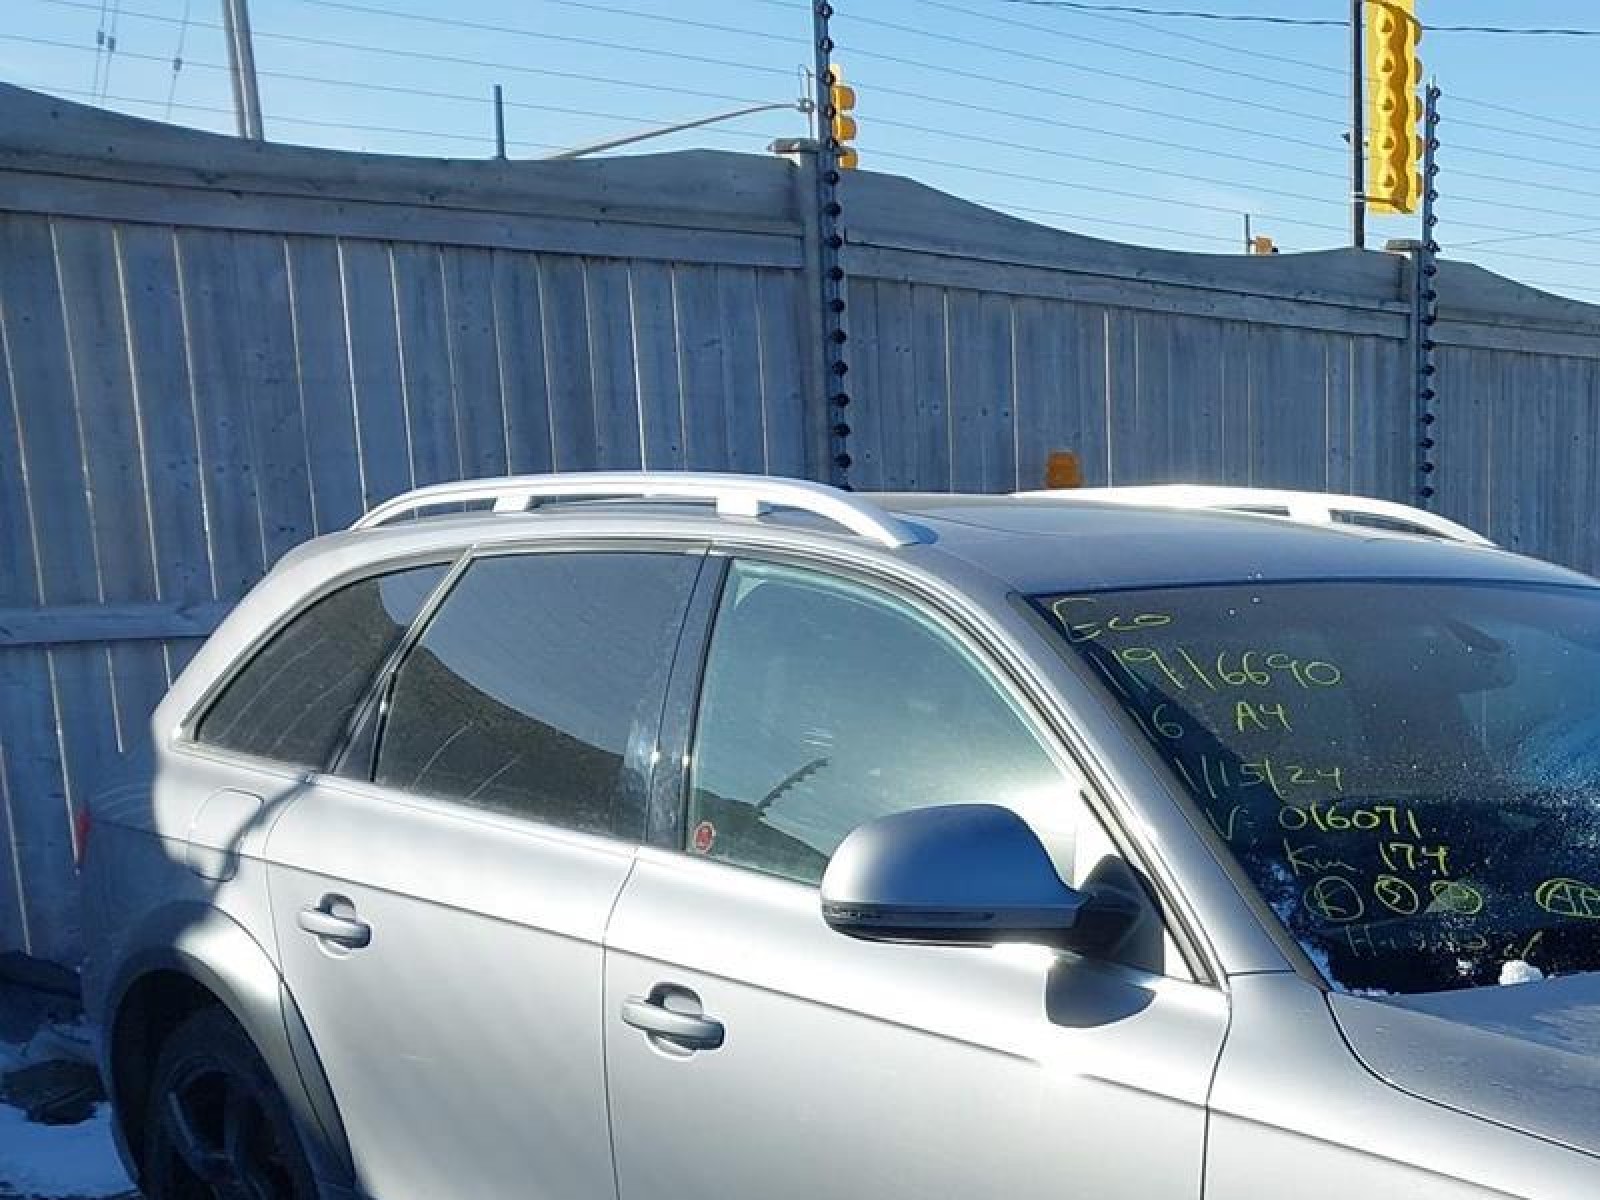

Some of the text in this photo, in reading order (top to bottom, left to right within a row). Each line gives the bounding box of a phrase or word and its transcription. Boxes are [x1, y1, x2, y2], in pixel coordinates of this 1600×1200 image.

[1235, 700, 1293, 733] A4
[1278, 801, 1423, 839] 016071
[1378, 841, 1450, 876] 174
